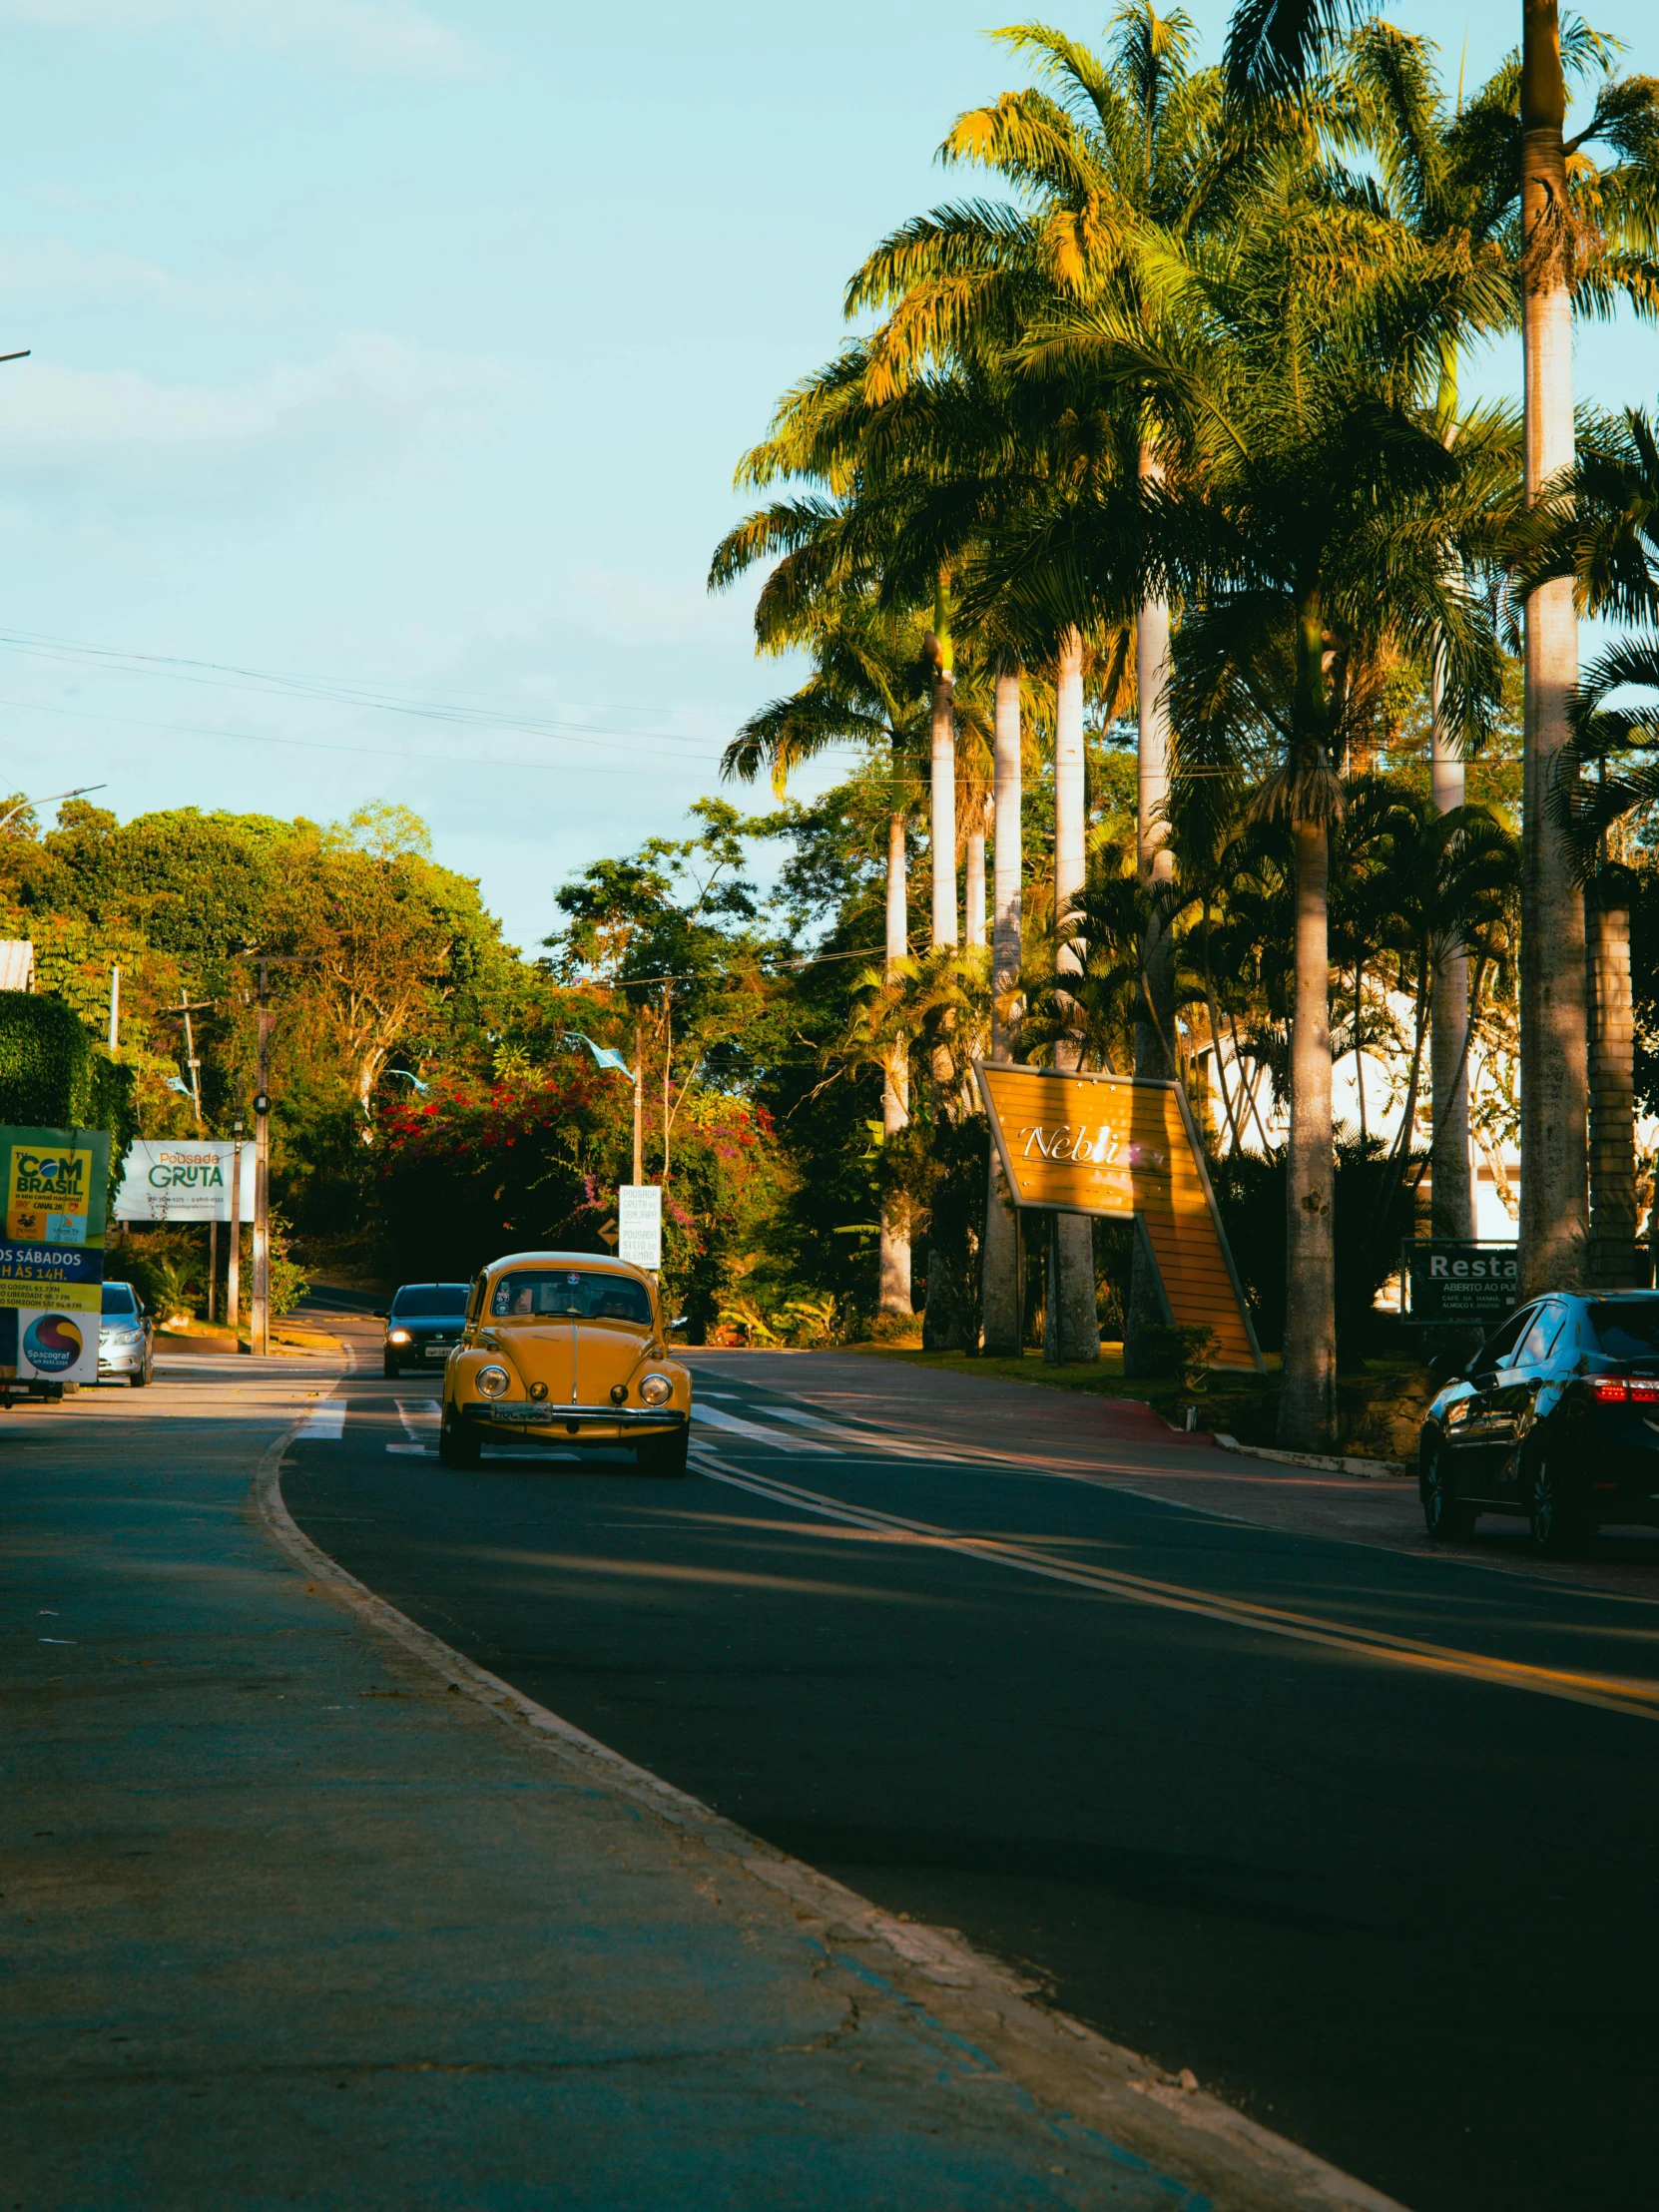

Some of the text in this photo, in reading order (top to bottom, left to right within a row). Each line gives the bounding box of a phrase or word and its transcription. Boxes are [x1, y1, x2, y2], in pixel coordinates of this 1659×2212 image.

[160, 1152, 220, 1165] Pousada
[18, 1155, 83, 1181] COM
[148, 1165, 224, 1188] GRUTA
[16, 1177, 84, 1195] BRASIL
[623, 1200, 648, 1209] GRUTA
[623, 1210, 657, 1219] UBAJARA
[623, 1230, 657, 1239] POUSADA
[16, 1248, 81, 1266] SÁBADOS
[1430, 1255, 1517, 1277] Resta
[0, 1263, 67, 1281] H ÀS 14H.
[1443, 1283, 1482, 1292] ABERTO
[1484, 1283, 1498, 1292] AO
